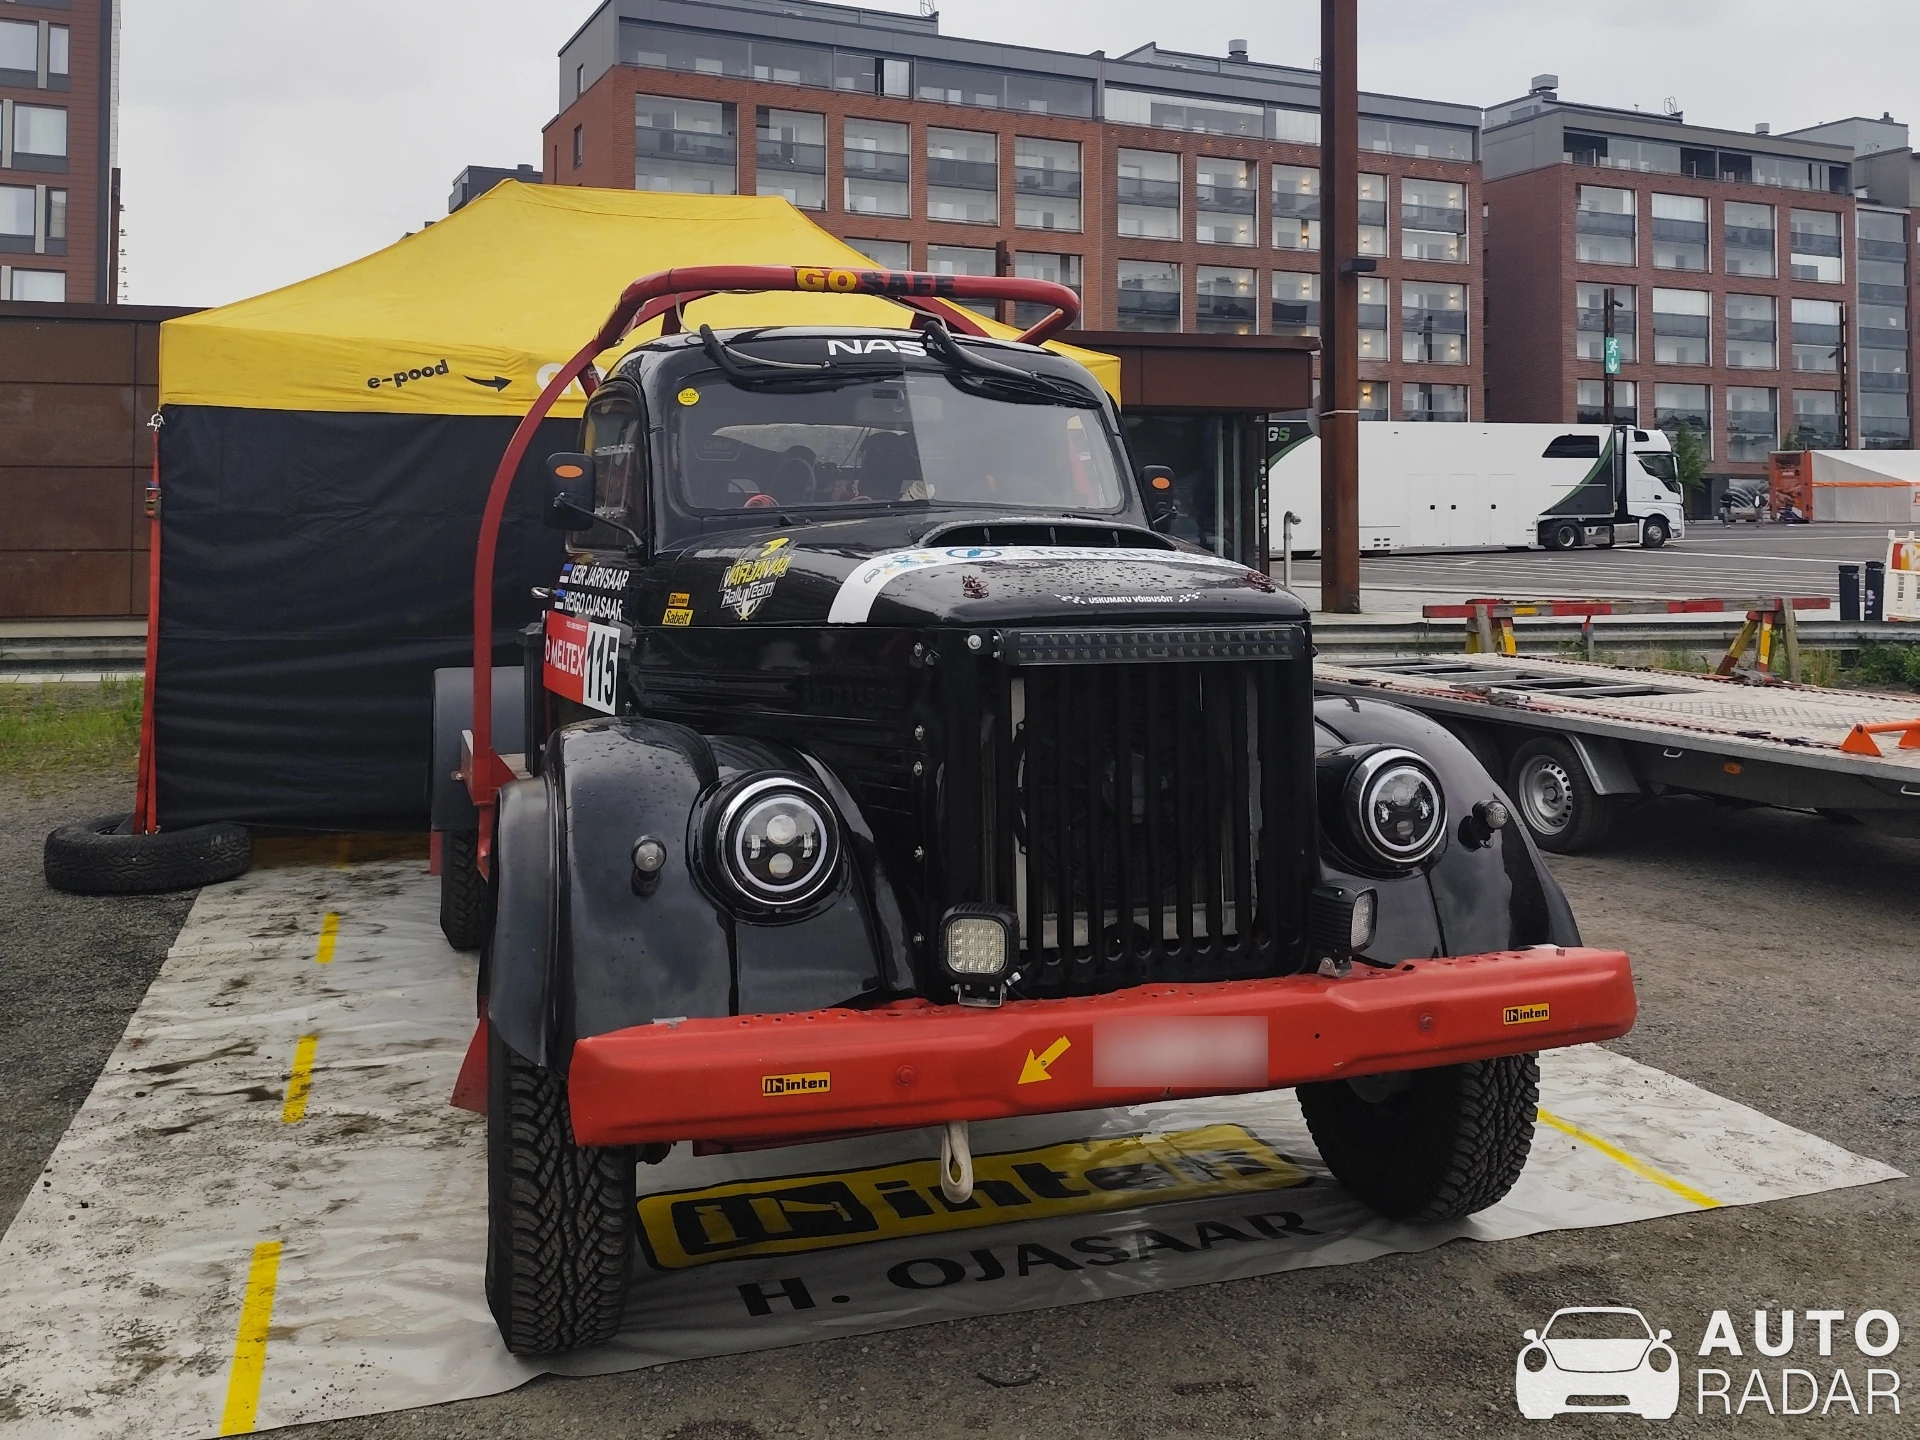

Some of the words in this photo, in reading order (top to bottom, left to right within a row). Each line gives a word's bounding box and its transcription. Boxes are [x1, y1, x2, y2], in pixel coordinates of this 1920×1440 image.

[367, 358, 450, 389] e-pood
[747, 581, 776, 600] Team
[1088, 596, 1131, 604] USKUMATU
[664, 610, 690, 625] Sabelt
[550, 638, 585, 678] MELTEX
[585, 630, 618, 707] 115
[1520, 1008, 1548, 1020] inten
[786, 1077, 828, 1091] inten
[737, 1280, 872, 1318] H.
[886, 1210, 1318, 1288] OJASAAR
